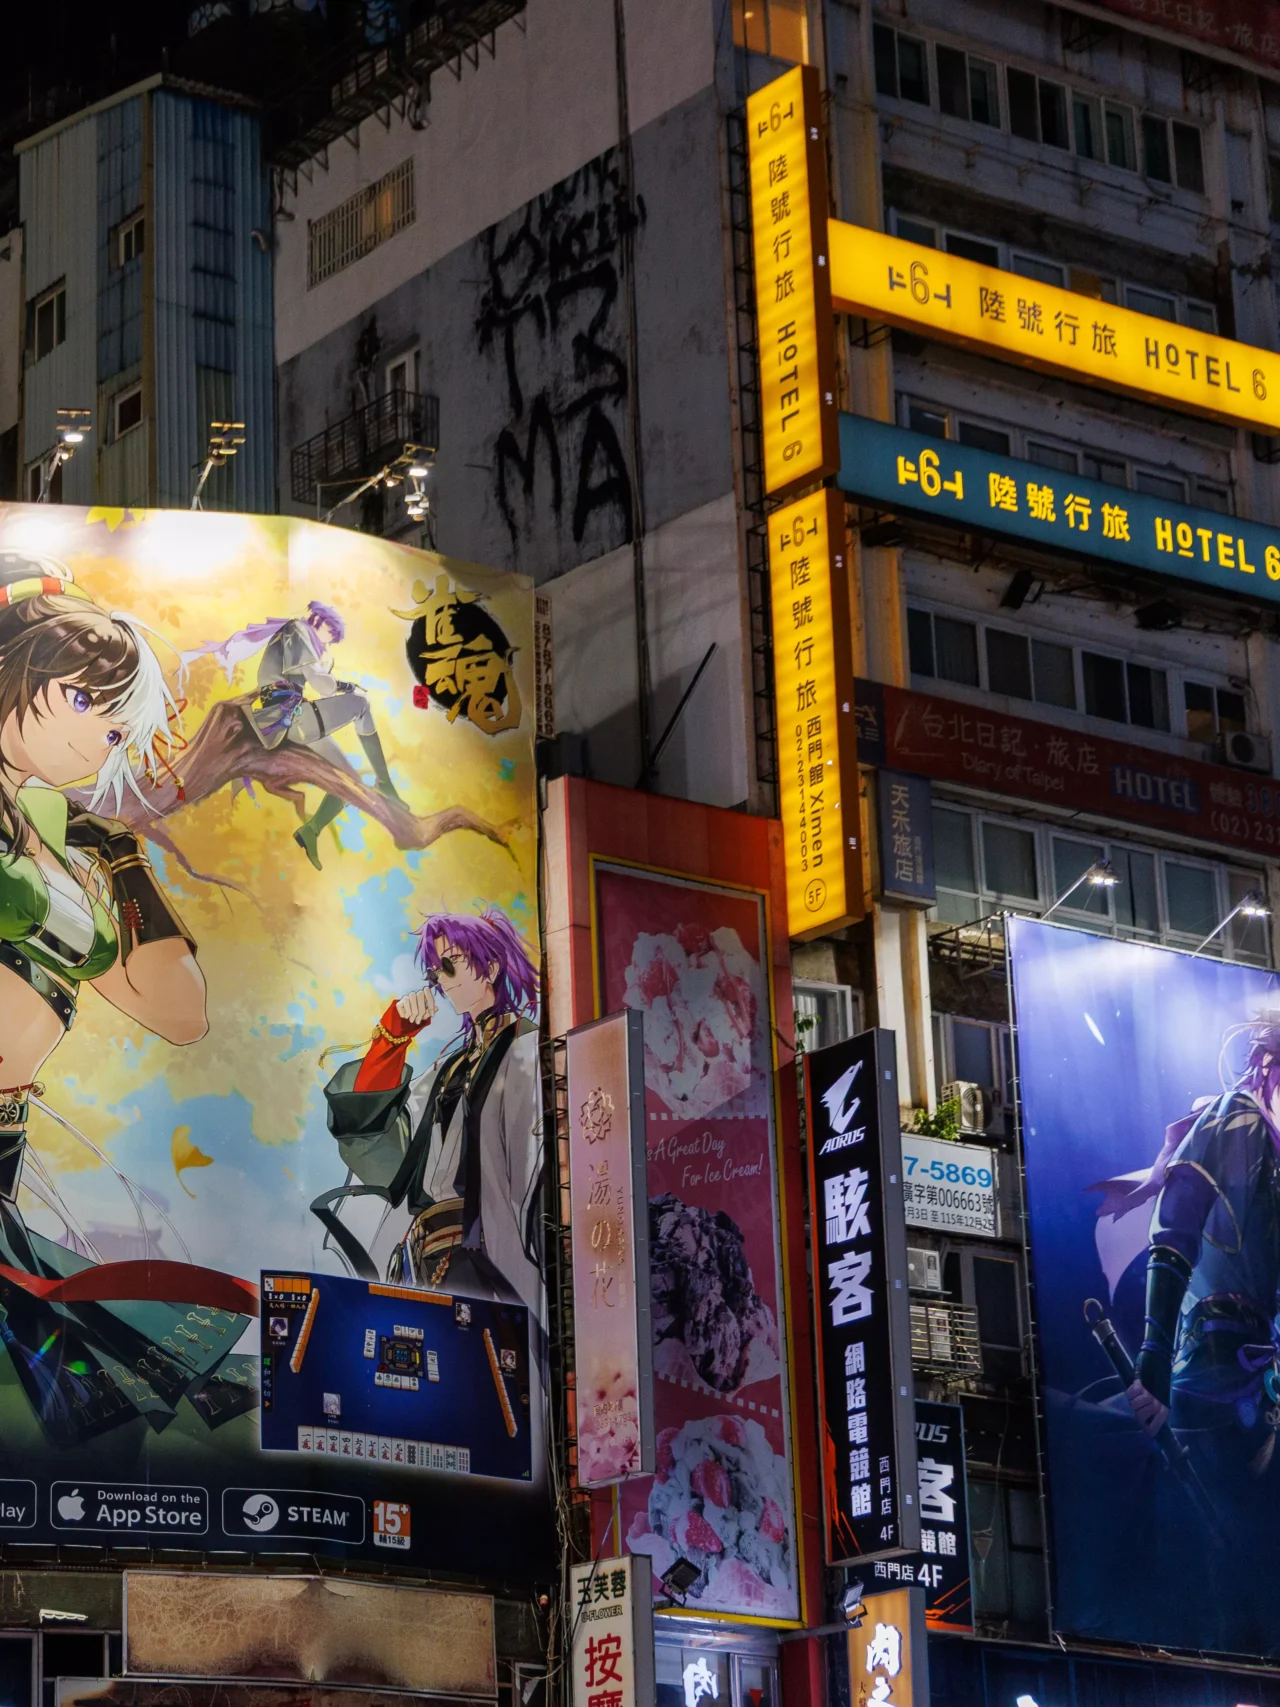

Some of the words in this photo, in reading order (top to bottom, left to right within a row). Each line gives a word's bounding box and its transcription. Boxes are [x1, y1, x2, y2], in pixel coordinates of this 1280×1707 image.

[769, 154, 796, 303] 陸號行旅
[978, 286, 1118, 359] 陸號行旅
[1144, 336, 1241, 394] HOTEL
[1251, 368, 1267, 401] 6
[783, 441, 803, 461] 6
[988, 472, 1131, 543] 陸號行旅
[1154, 516, 1256, 574] HOTEL
[1264, 544, 1280, 582] 6
[789, 555, 818, 713] 陸號行旅
[806, 715, 824, 788] 西門館
[795, 724, 809, 872] 02-23144003
[1114, 766, 1198, 812] HOTEL
[809, 790, 825, 869] Ximen
[890, 784, 915, 883] 天禾旅店
[808, 889, 822, 906] 5F
[667, 1135, 701, 1165] Great
[703, 1130, 727, 1160] Day
[819, 1126, 866, 1155] AORUS
[681, 1166, 703, 1189] For
[722, 1153, 763, 1182] Cream!
[930, 1209, 939, 1223] 至
[824, 1167, 875, 1327] 駭客
[843, 1340, 872, 1518] 網路電競館
[97, 1490, 158, 1503] Download
[162, 1494, 176, 1503] on
[180, 1493, 200, 1504] the
[878, 1456, 893, 1516] 西門店
[96, 1504, 141, 1528] App
[145, 1505, 202, 1526] Store
[287, 1506, 347, 1527] STEAM
[880, 1524, 894, 1542] 4F
[873, 1560, 914, 1582] 西門店
[917, 1563, 943, 1589] 4F
[581, 1604, 623, 1623] U-FLOWER
